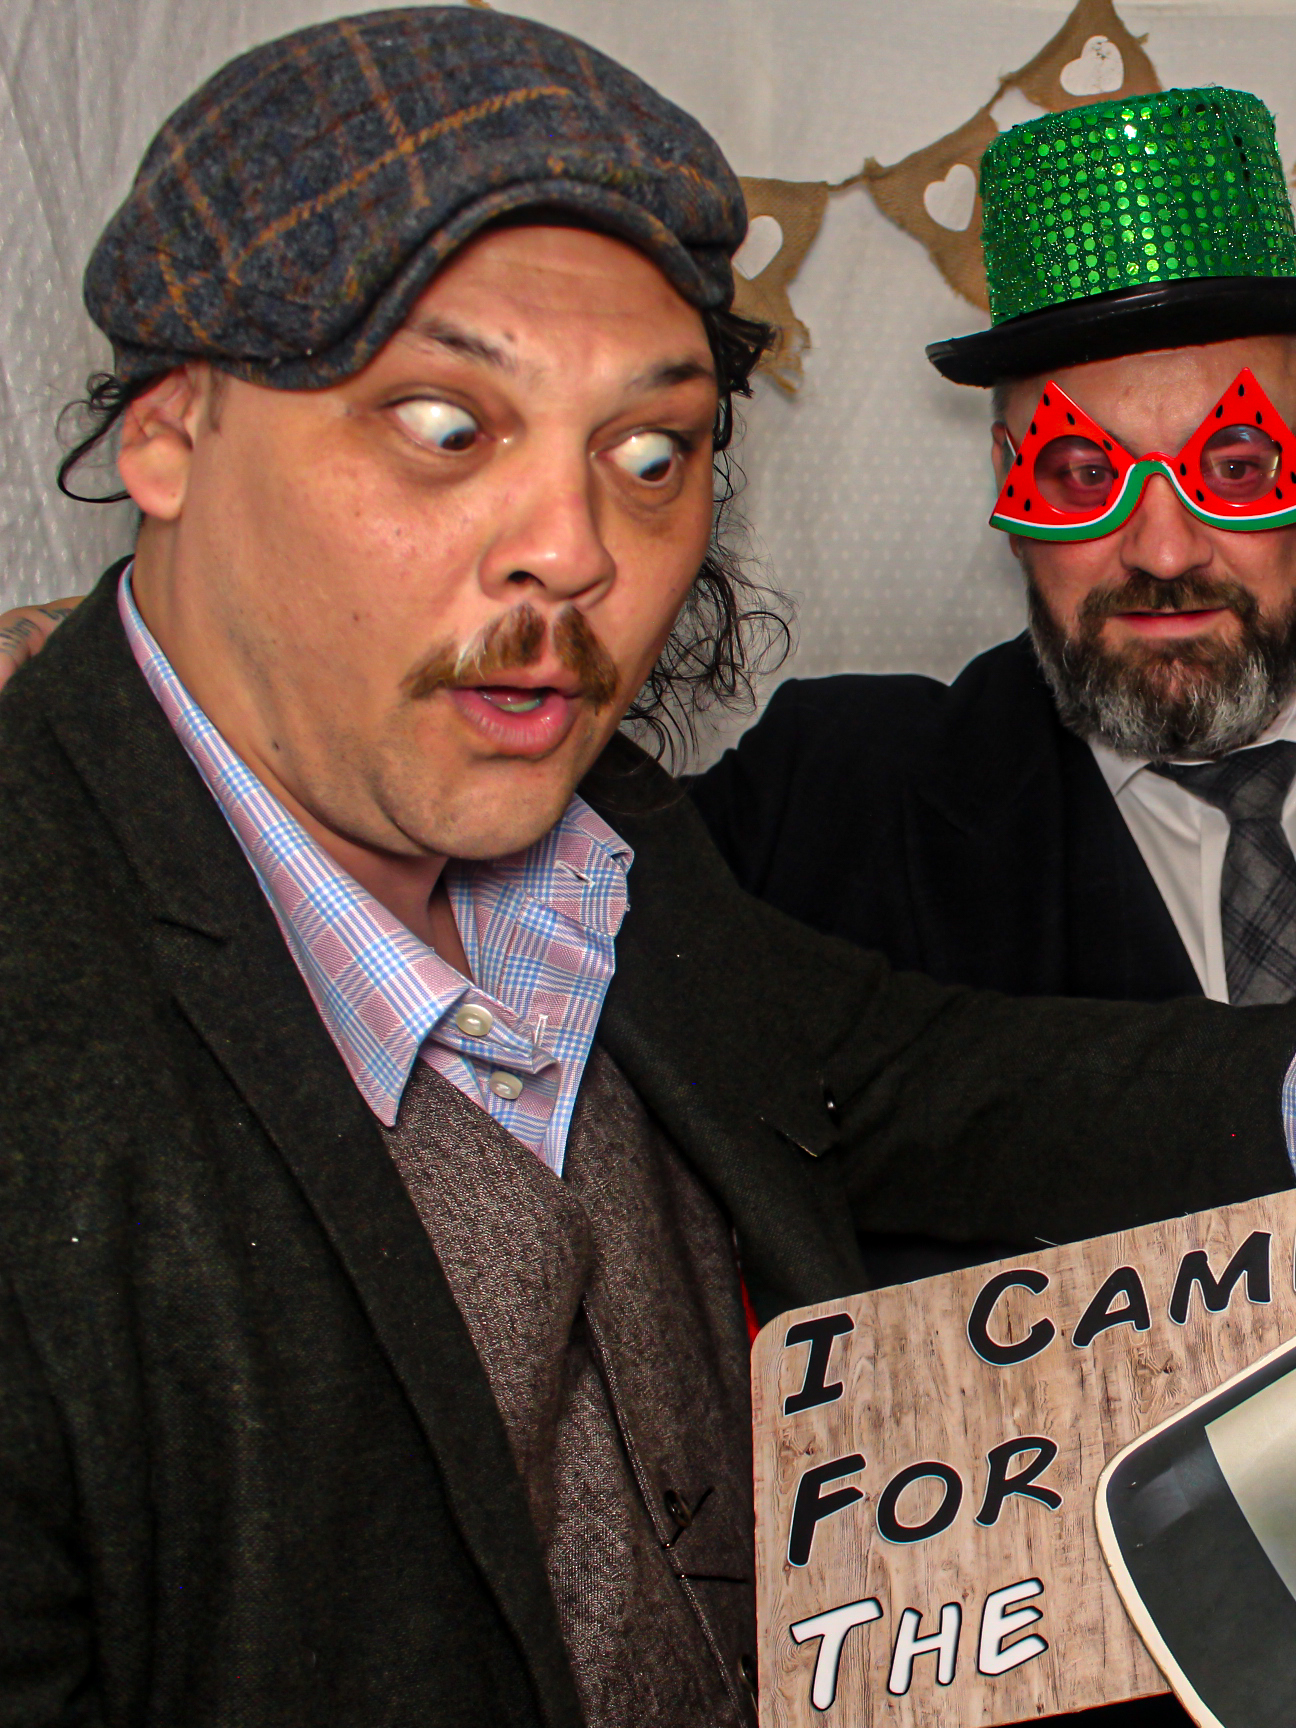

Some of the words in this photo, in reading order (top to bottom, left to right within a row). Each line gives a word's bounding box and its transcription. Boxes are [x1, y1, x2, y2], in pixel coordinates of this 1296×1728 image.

[783, 1312, 855, 1417] I
[786, 1435, 1064, 1568] FOR
[789, 1577, 1049, 1712] THE
